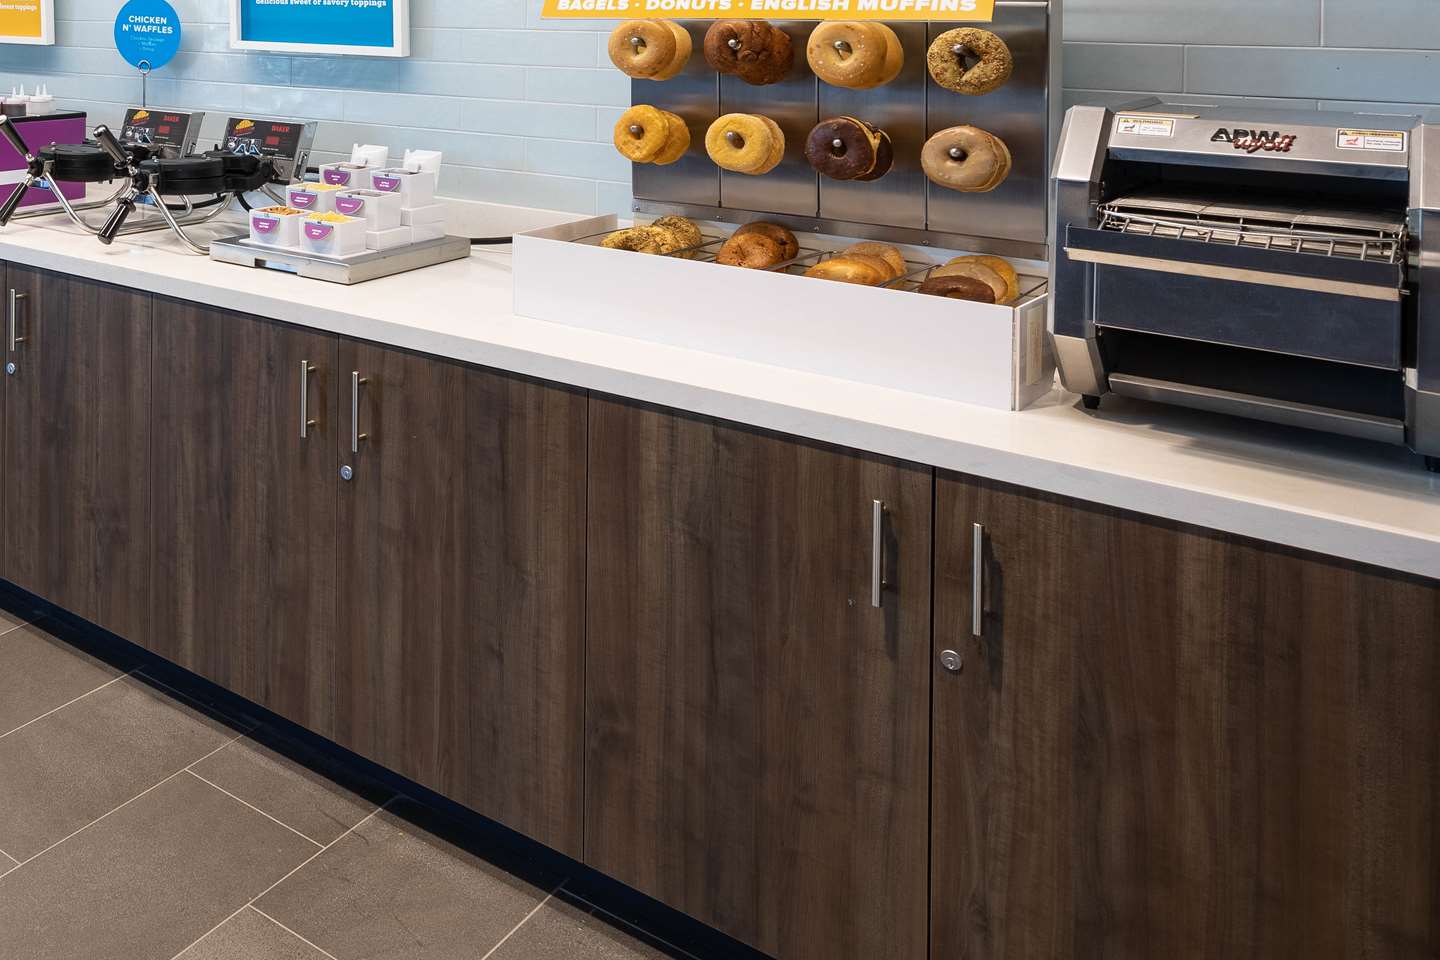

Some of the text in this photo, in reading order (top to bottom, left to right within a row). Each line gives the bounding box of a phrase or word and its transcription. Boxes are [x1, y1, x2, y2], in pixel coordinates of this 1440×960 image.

[323, 0, 350, 7] savory
[351, 0, 387, 7] toppings
[128, 15, 167, 25] CHICKEN
[133, 25, 173, 34] WAFFLES
